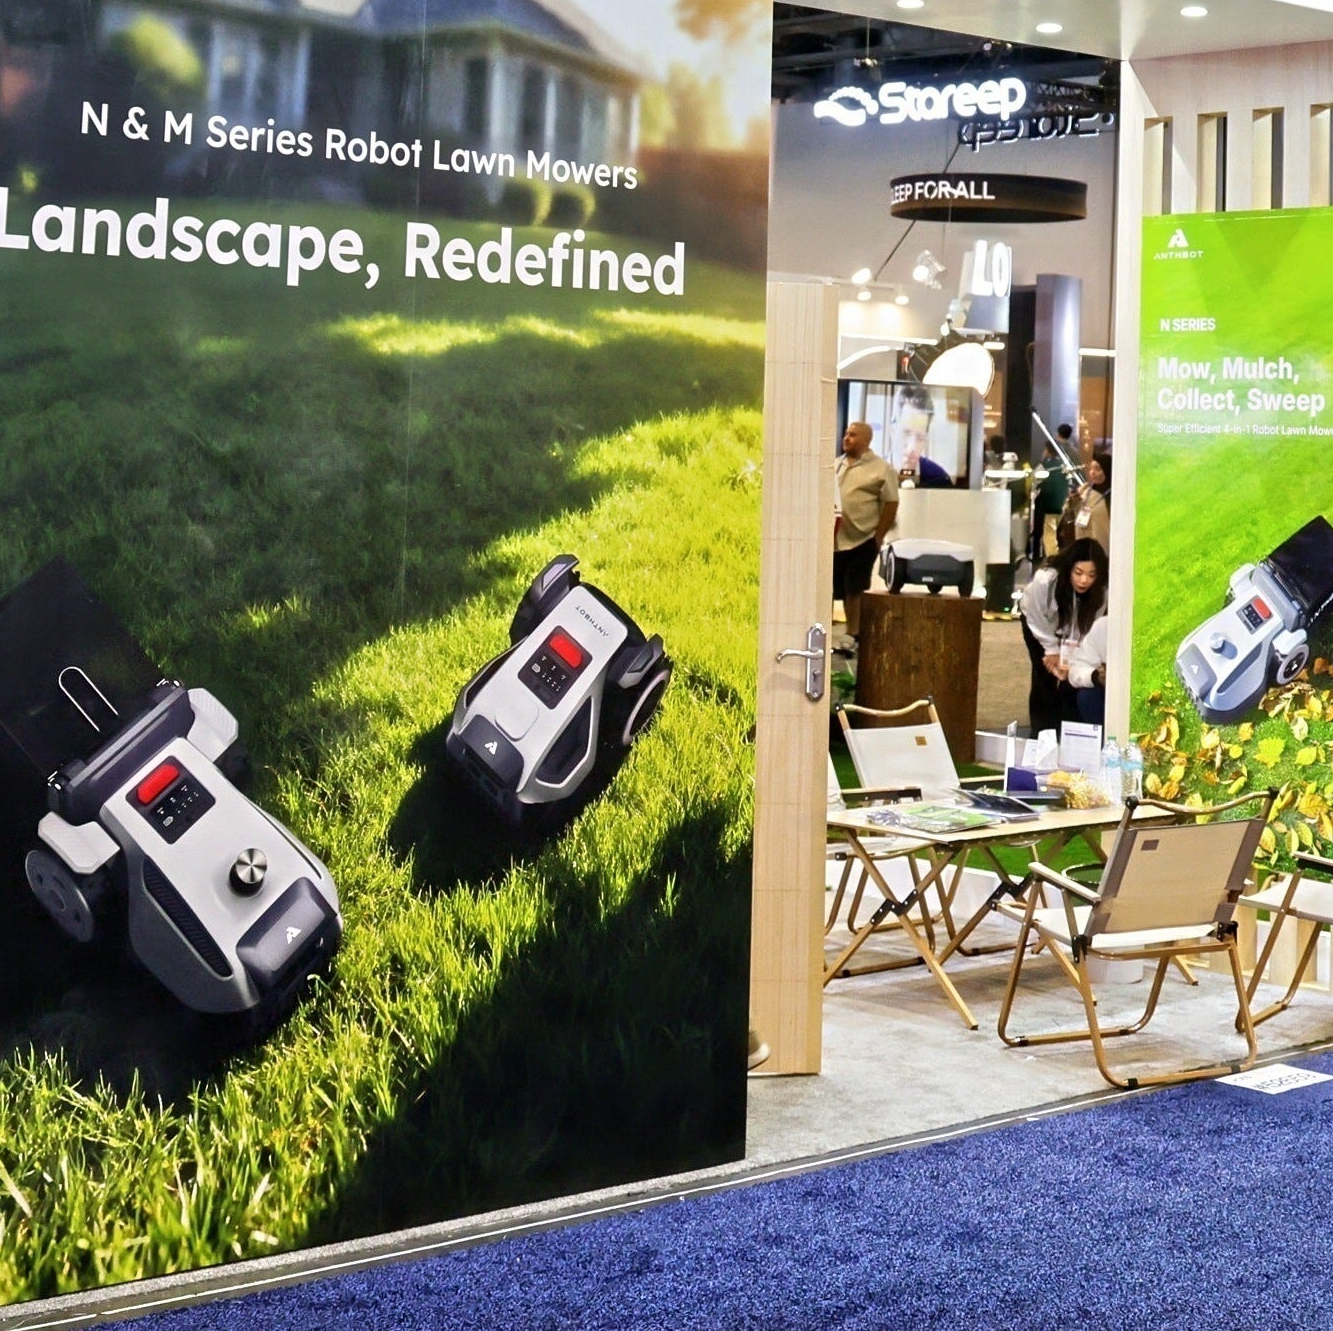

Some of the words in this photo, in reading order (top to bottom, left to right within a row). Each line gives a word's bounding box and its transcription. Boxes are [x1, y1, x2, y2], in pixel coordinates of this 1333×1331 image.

[81, 101, 110, 137] N
[122, 106, 151, 141] &
[164, 110, 194, 146] M
[207, 115, 314, 158] Series
[325, 127, 424, 169] Robot
[433, 138, 515, 178] Lawn
[527, 150, 639, 191] Mowers
[914, 180, 950, 200] FOR
[954, 180, 996, 200] ALL
[405, 220, 686, 297] Redefined
[1153, 250, 1204, 261] ANTHBOT
[1160, 318, 1170, 332] N
[1172, 317, 1216, 332] SERIES
[1157, 356, 1216, 385] Mow,
[1222, 356, 1300, 385] Mulch,
[1157, 387, 1241, 416] Collect,
[1247, 387, 1326, 417] Sweep
[1157, 424, 1182, 437] Super
[1184, 422, 1221, 434] Efficient
[1223, 423, 1251, 435] 4-in-1
[1252, 423, 1280, 435] Robot
[1282, 423, 1307, 436] Lawn
